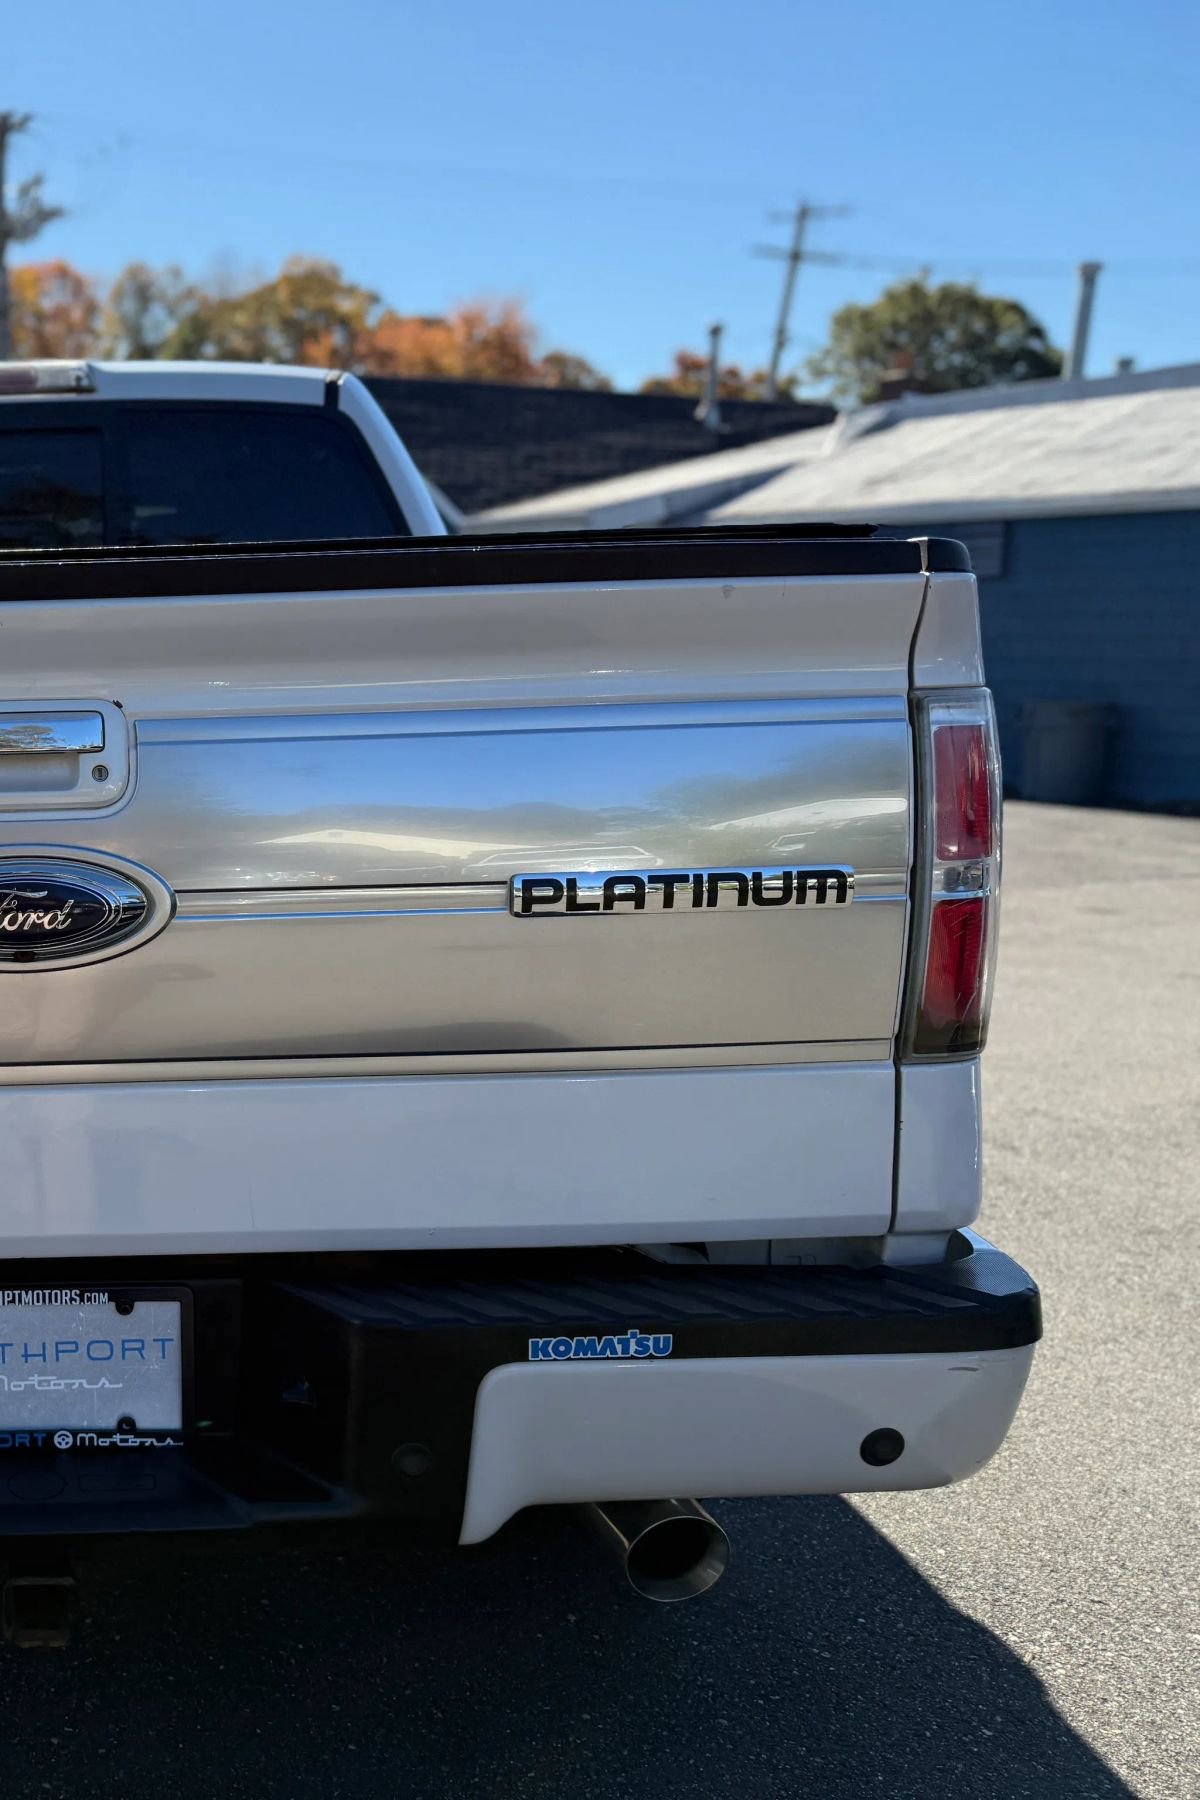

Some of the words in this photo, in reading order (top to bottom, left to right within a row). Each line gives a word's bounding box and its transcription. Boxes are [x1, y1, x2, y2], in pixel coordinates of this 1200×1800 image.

[520, 868, 849, 914] PLATINUM
[529, 1329, 673, 1360] KOMATSU
[76, 1431, 184, 1448] Motors
